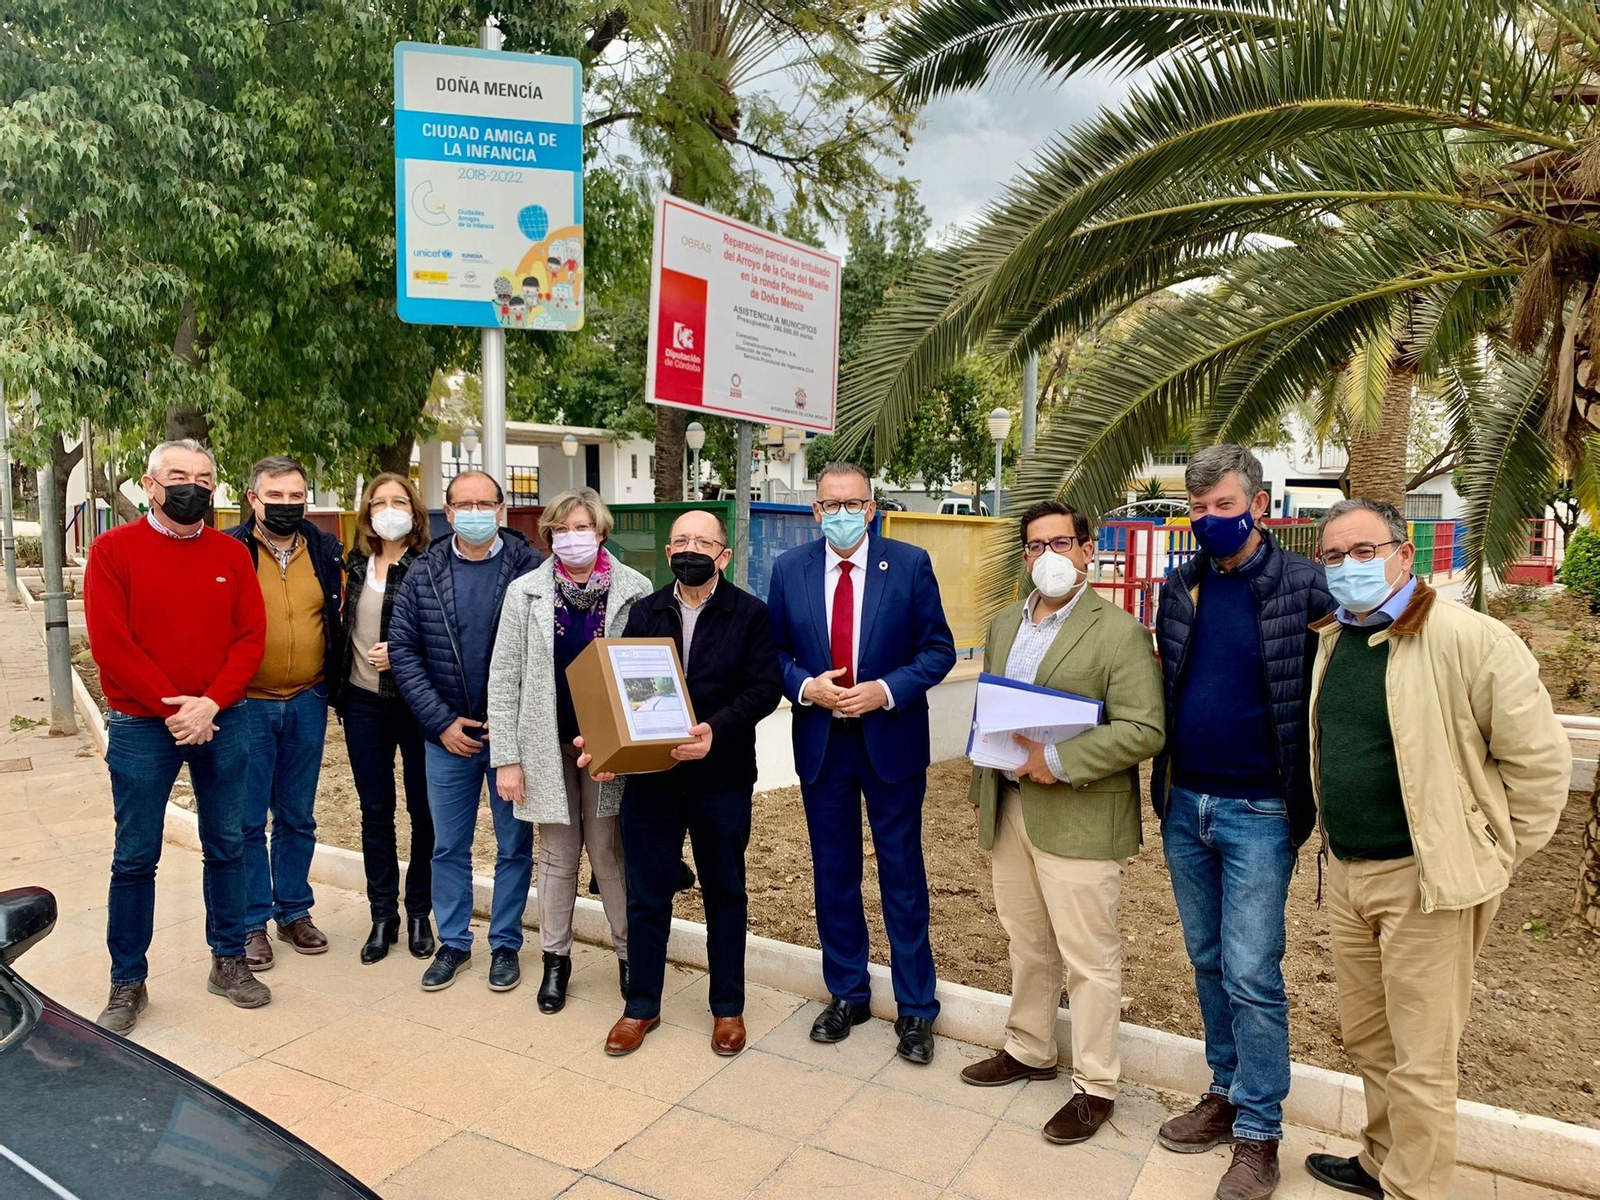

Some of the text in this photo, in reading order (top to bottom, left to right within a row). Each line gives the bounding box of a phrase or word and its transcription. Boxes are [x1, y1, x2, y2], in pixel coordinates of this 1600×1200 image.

[436, 76, 543, 100] DOÑA MENCÍA
[422, 123, 557, 147] CIUDAD AMIGA DE
[444, 142, 536, 162] LA INFANCIA
[458, 168, 523, 183] 2018-2022
[413, 249, 441, 258] unicef
[681, 236, 712, 254] OBRAS
[723, 233, 830, 278] Reparación parcial del entubado
[724, 250, 829, 292] del Arroyo de la Cruz del Muelle
[740, 271, 814, 300] en la ronda Povedano
[750, 288, 759, 299] de
[761, 290, 780, 306] Doña
[733, 305, 774, 322] ASISTENCIA
[781, 318, 817, 334] MUNICIPIOS
[664, 358, 700, 372] de Córdoba
[665, 348, 701, 363] Diputación
